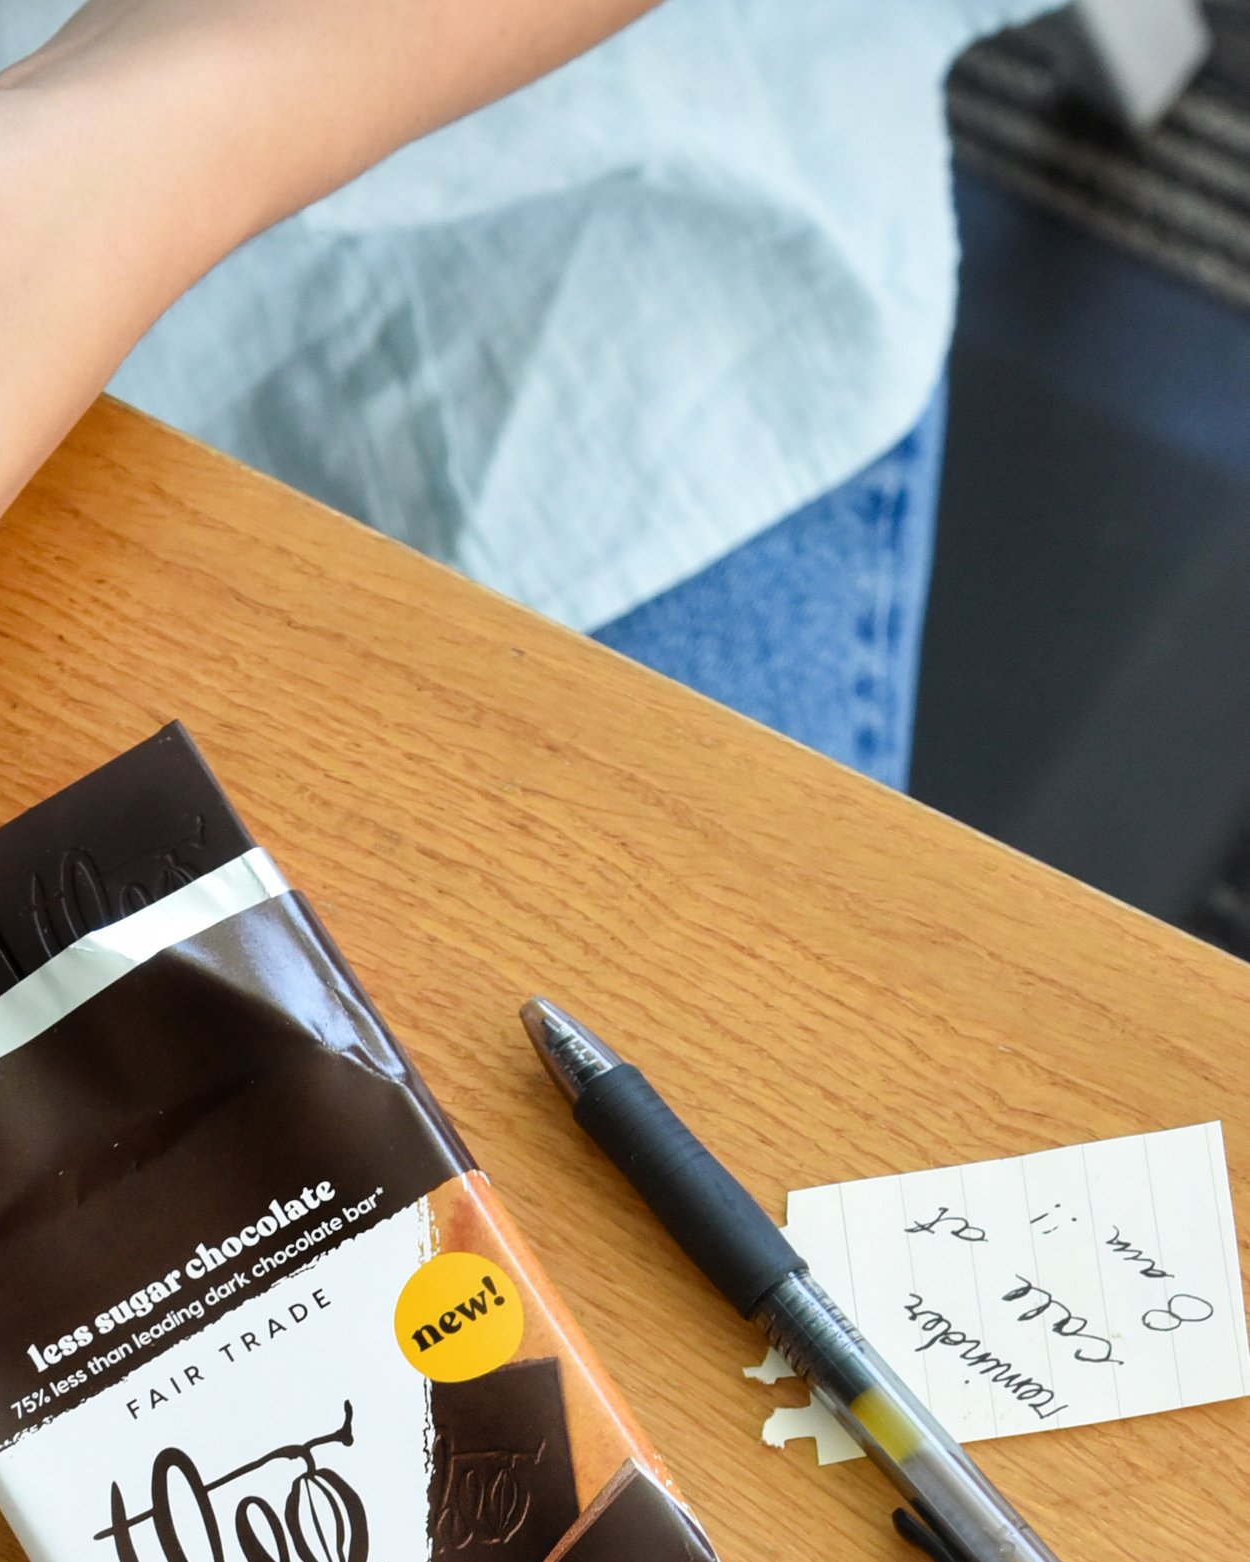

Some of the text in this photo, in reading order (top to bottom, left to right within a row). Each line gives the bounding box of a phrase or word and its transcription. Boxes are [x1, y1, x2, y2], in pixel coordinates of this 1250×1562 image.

[904, 1207, 988, 1243] at
[1105, 1226, 1175, 1279] am
[10, 1388, 51, 1419] 75%
[50, 1370, 88, 1397] less
[87, 1342, 133, 1375] than
[131, 1300, 205, 1349] leading
[204, 1272, 251, 1306] dark
[251, 1216, 343, 1278] chocolate
[27, 1181, 335, 1373] less sugar chocolate
[410, 1275, 507, 1353] new!
[1142, 1294, 1214, 1332] 8
[126, 1288, 332, 1420] FAIR TRADE
[904, 1293, 1068, 1420] reminder
